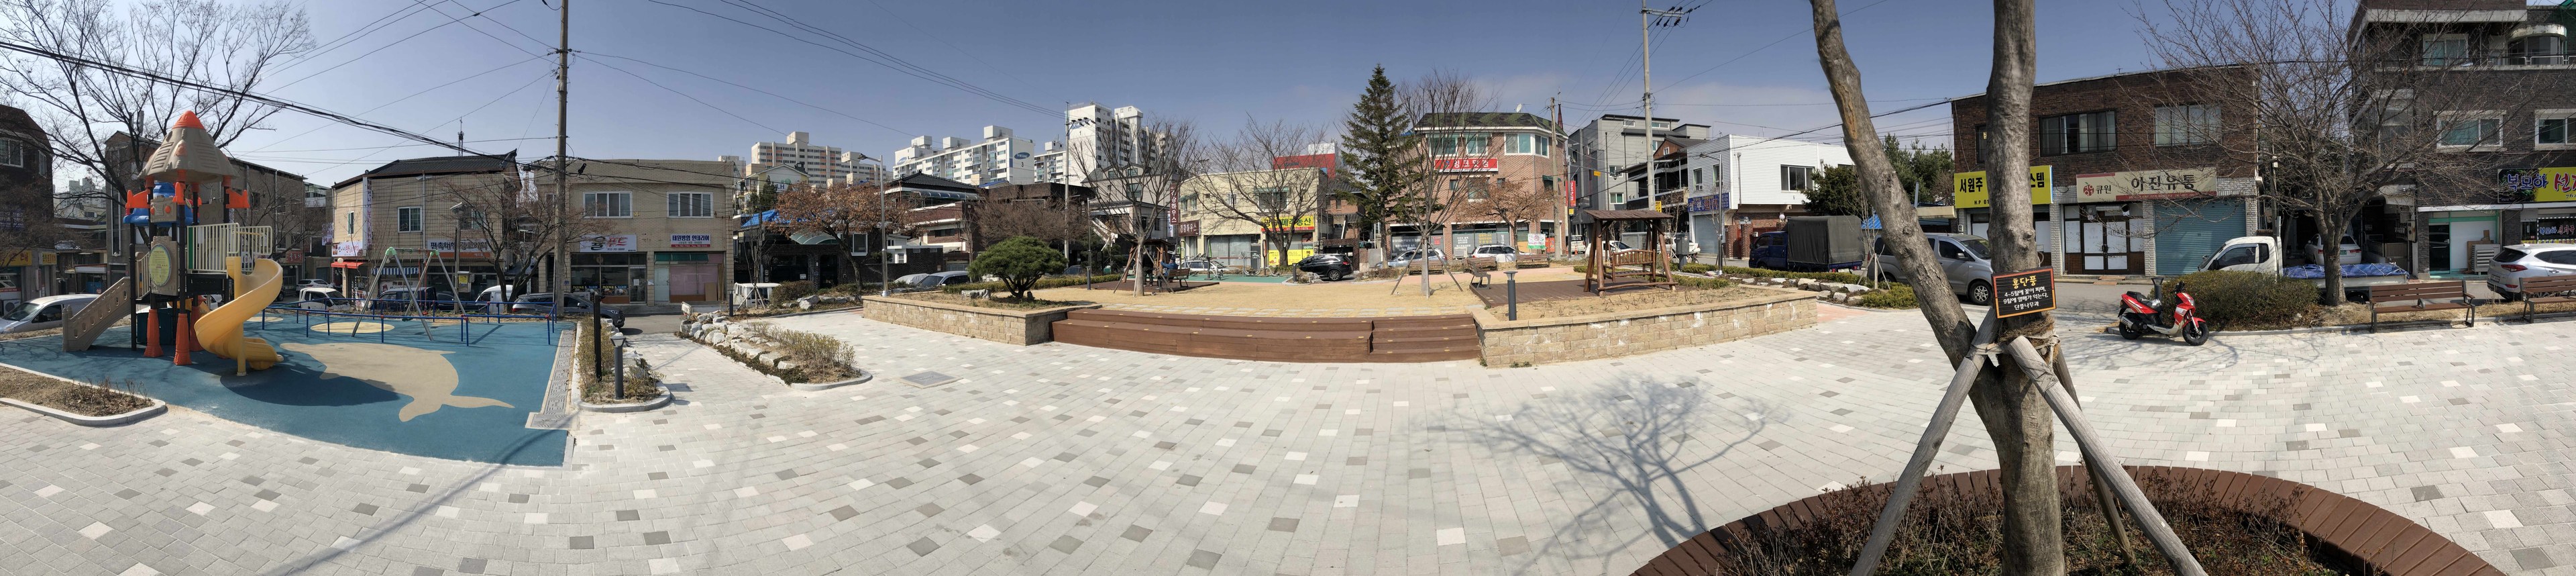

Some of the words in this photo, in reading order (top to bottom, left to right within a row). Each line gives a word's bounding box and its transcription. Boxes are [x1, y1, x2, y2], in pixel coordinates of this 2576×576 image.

[1960, 177, 1983, 193] 서원주
[2131, 175, 2196, 191] 아진유통
[2095, 185, 2112, 195] 큐원
[2012, 275, 2037, 289] 홍단풍
[2004, 289, 2024, 297] 4~5월에
[2014, 301, 2039, 310] 단풍나무과
